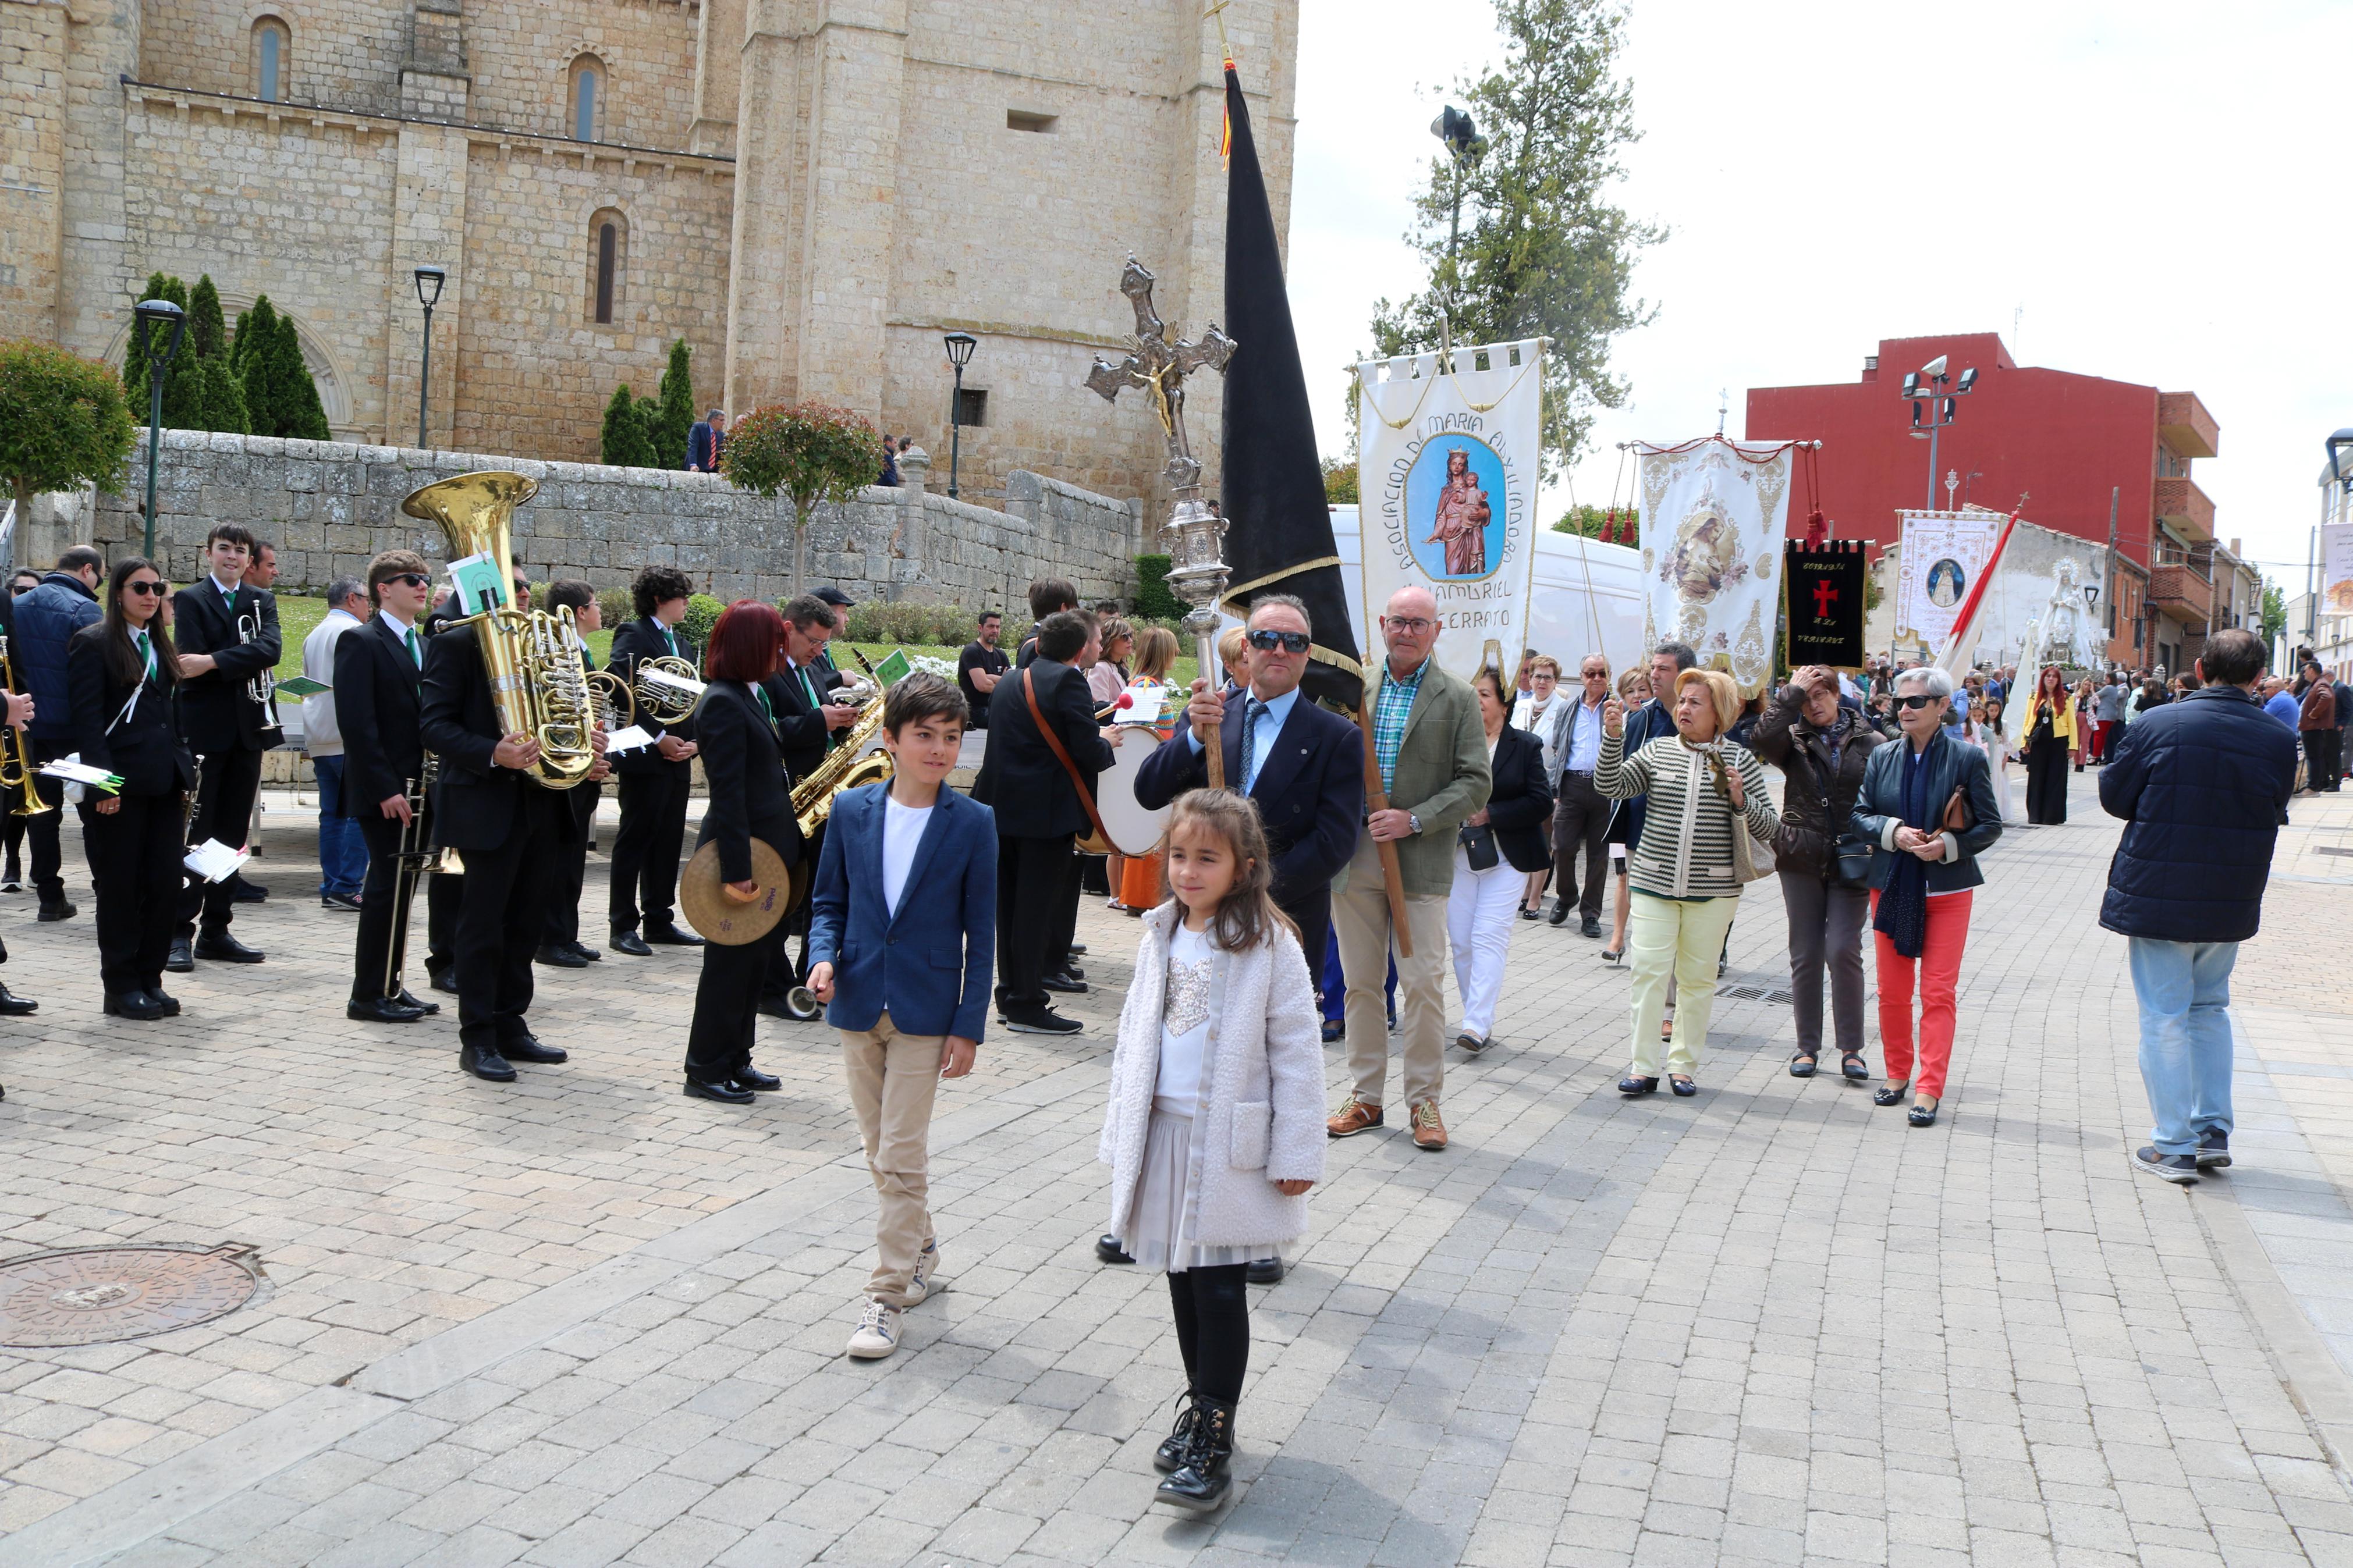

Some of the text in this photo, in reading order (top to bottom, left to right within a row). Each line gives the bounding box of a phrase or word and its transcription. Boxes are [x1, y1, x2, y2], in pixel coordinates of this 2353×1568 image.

[1382, 413, 1523, 570] ASOCIACION DE MARIA AUXILIADORA
[1403, 581, 1512, 601] AMURIEL
